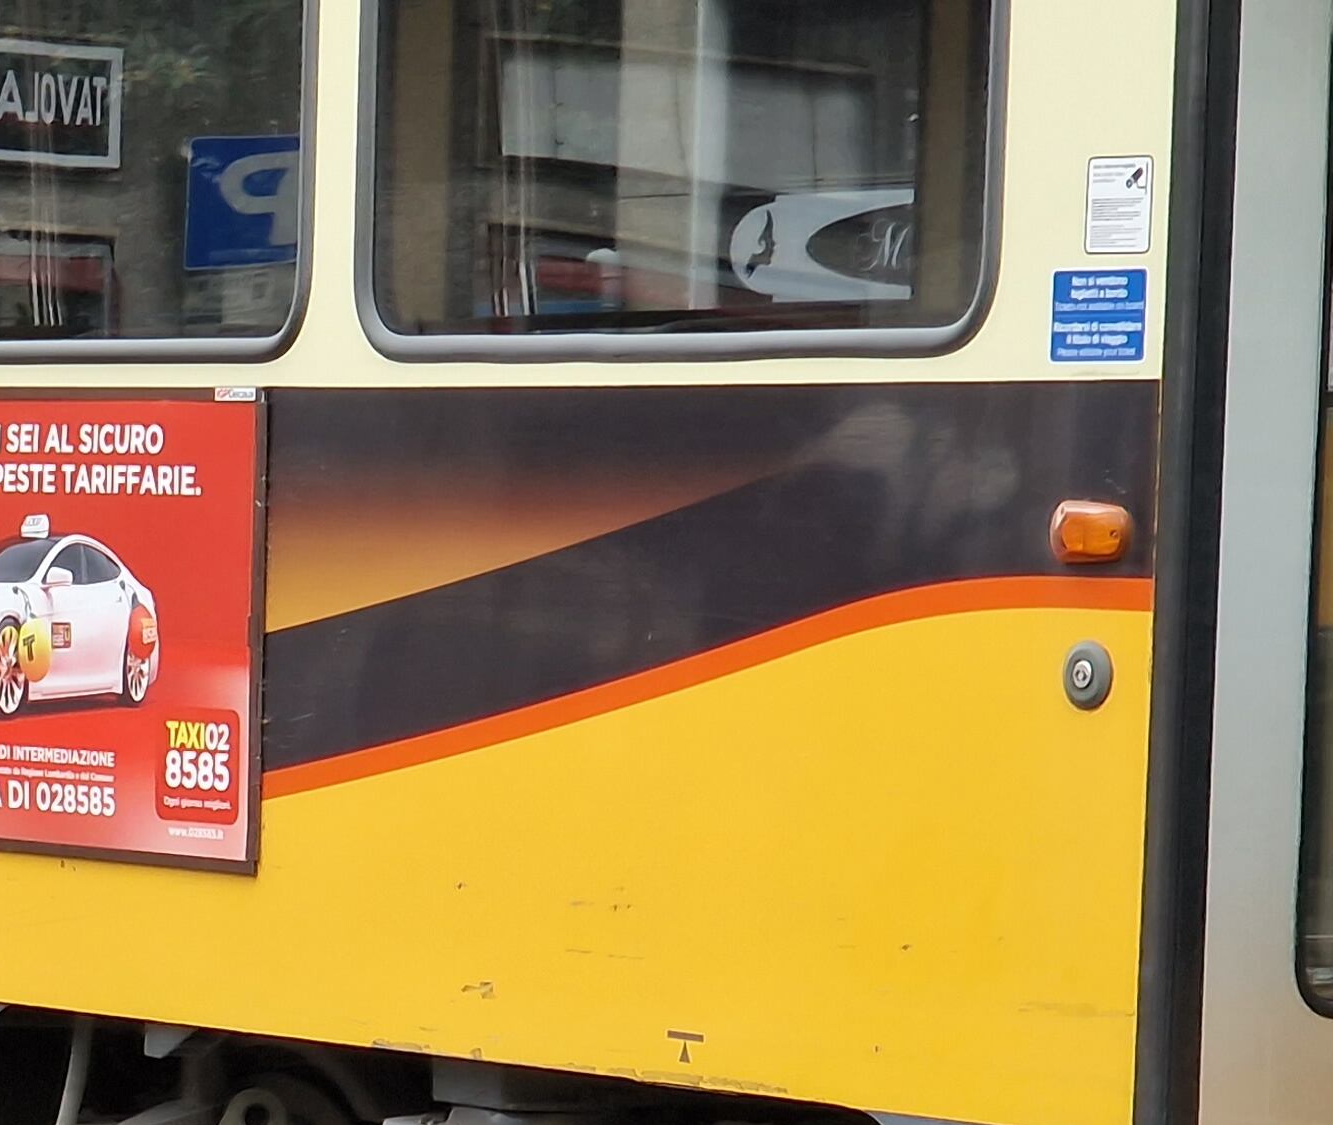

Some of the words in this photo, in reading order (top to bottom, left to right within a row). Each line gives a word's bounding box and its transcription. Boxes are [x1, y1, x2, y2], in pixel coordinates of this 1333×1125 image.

[6, 423, 40, 453] SEI
[44, 423, 74, 454] AL
[78, 423, 164, 455] SICURO
[61, 463, 202, 496] TARIFFARIE.
[12, 745, 115, 767] INTERMEDIAZIONE
[165, 749, 230, 791] 8585
[8, 779, 30, 810] DI
[36, 782, 116, 817] 028585
